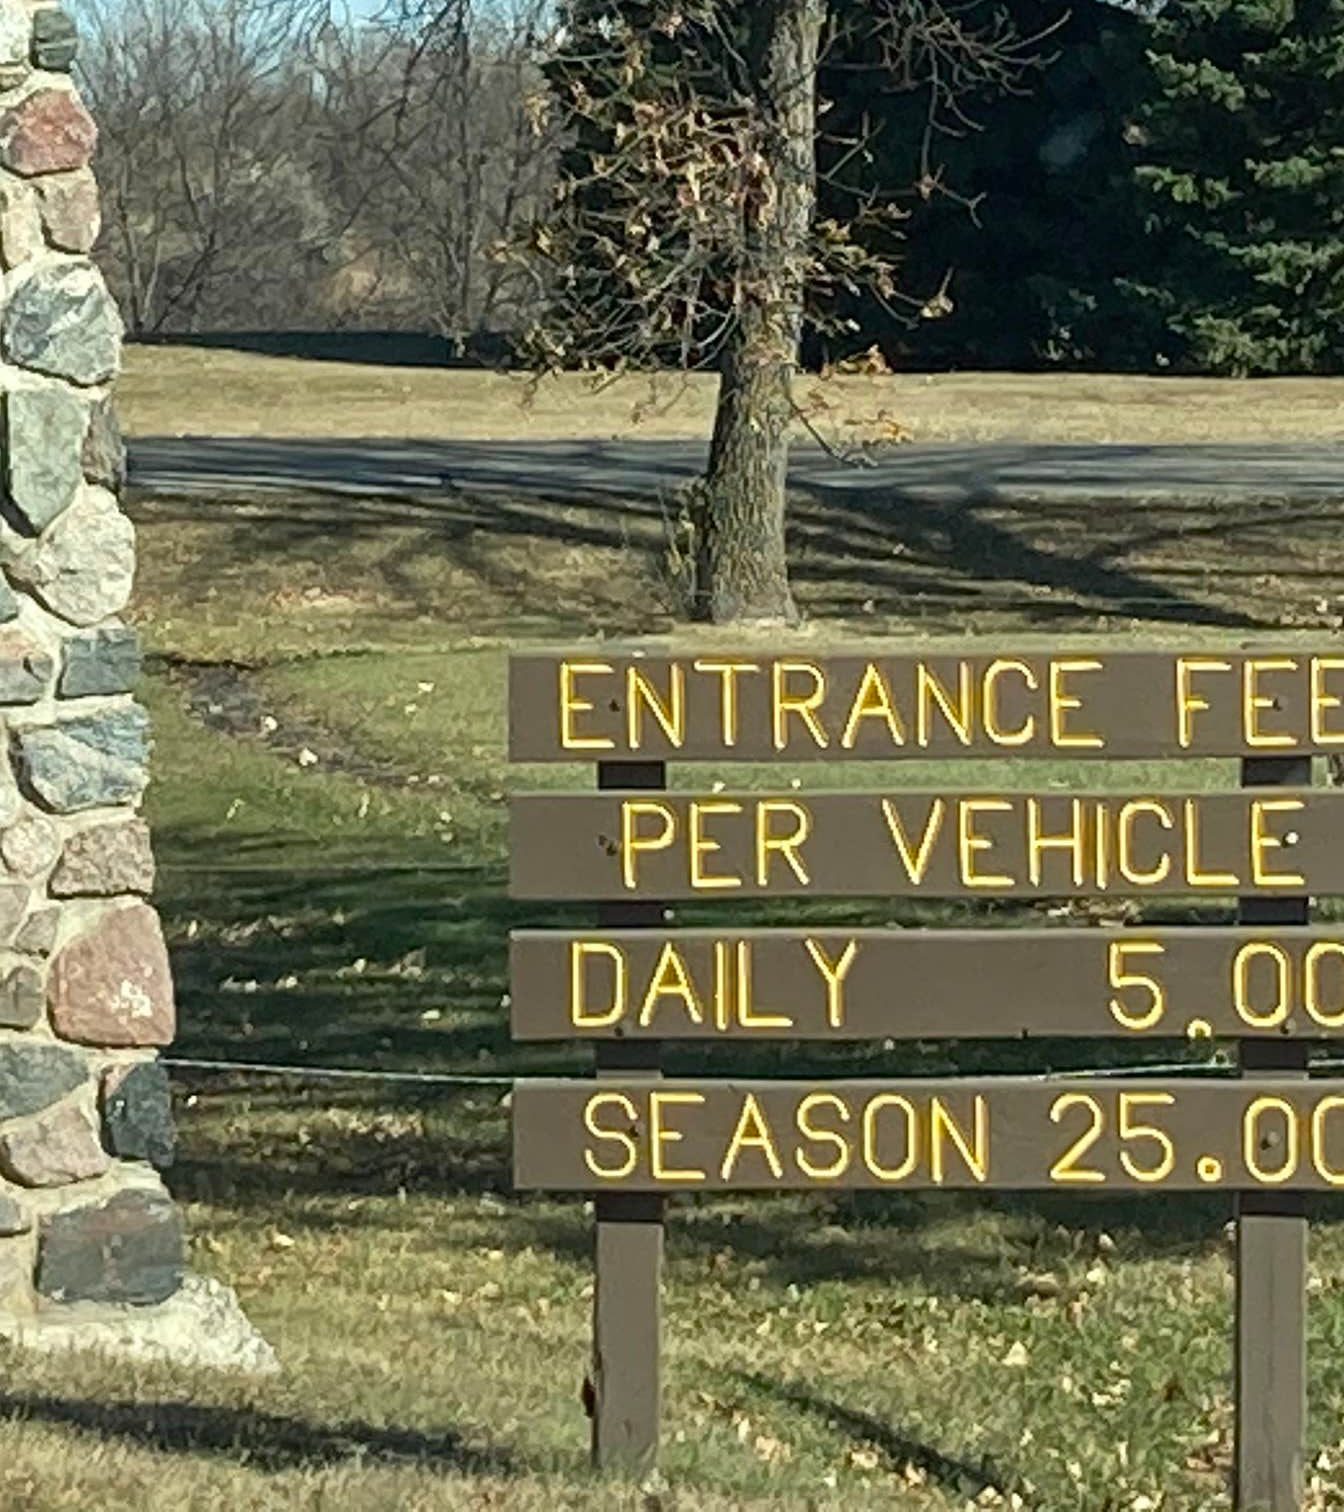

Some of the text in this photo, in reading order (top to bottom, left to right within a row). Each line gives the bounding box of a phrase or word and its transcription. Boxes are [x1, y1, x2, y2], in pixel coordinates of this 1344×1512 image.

[558, 659, 1105, 752] ENTRANCE
[621, 798, 1306, 889] PER VEHICLE
[569, 939, 859, 1031] DAILY
[582, 1092, 992, 1186] SEASON
